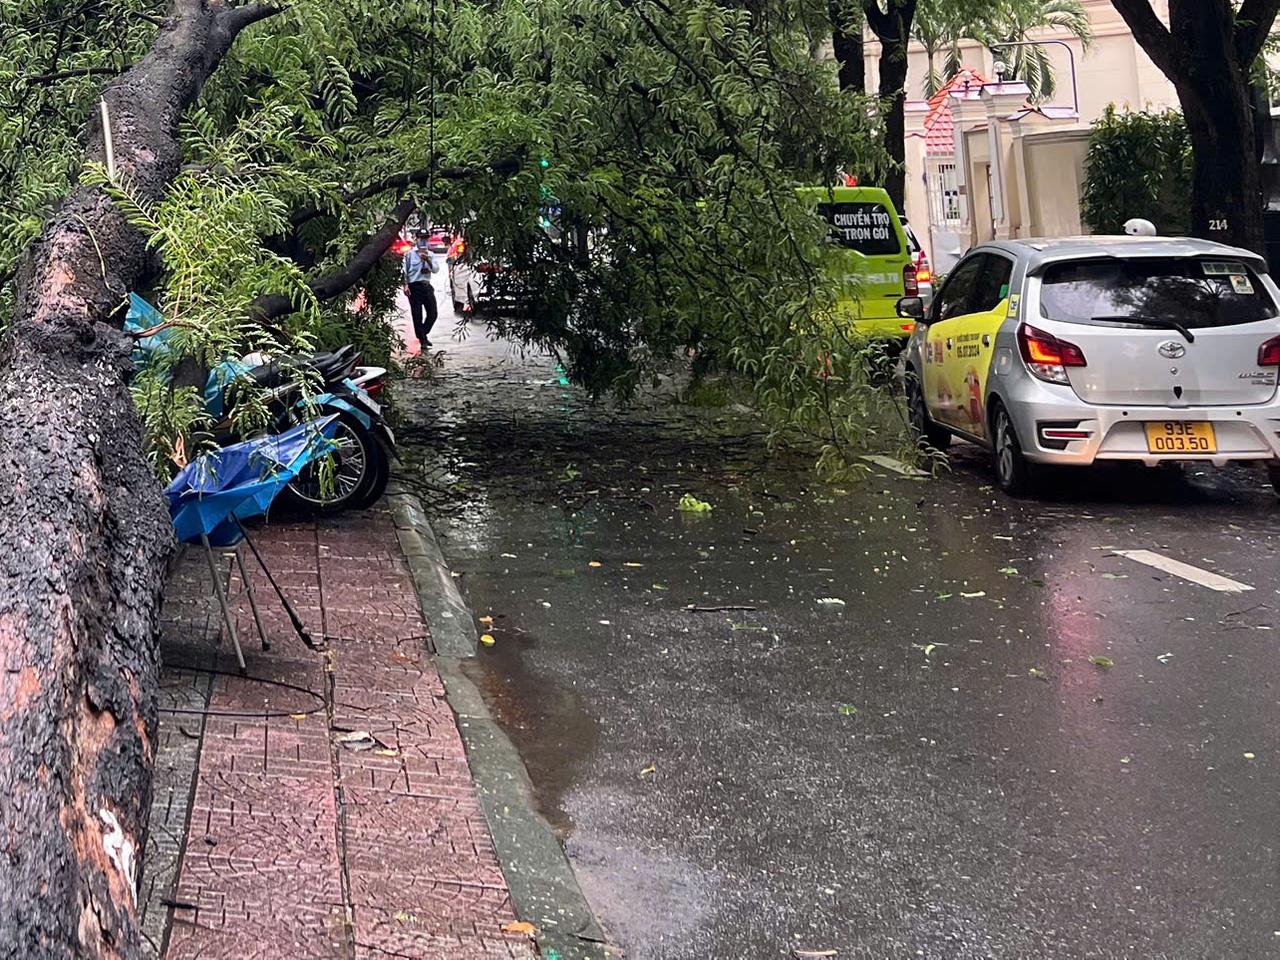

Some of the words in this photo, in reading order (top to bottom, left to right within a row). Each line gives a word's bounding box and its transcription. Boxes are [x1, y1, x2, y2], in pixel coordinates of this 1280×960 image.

[833, 208, 871, 226] CHUYỂN
[872, 212, 890, 227] TRỌ
[1208, 219, 1228, 231] 214
[844, 227, 871, 244] TRỌN
[872, 225, 889, 240] GÓI
[1164, 422, 1194, 436] 93E
[1155, 437, 1209, 451] 003.50
